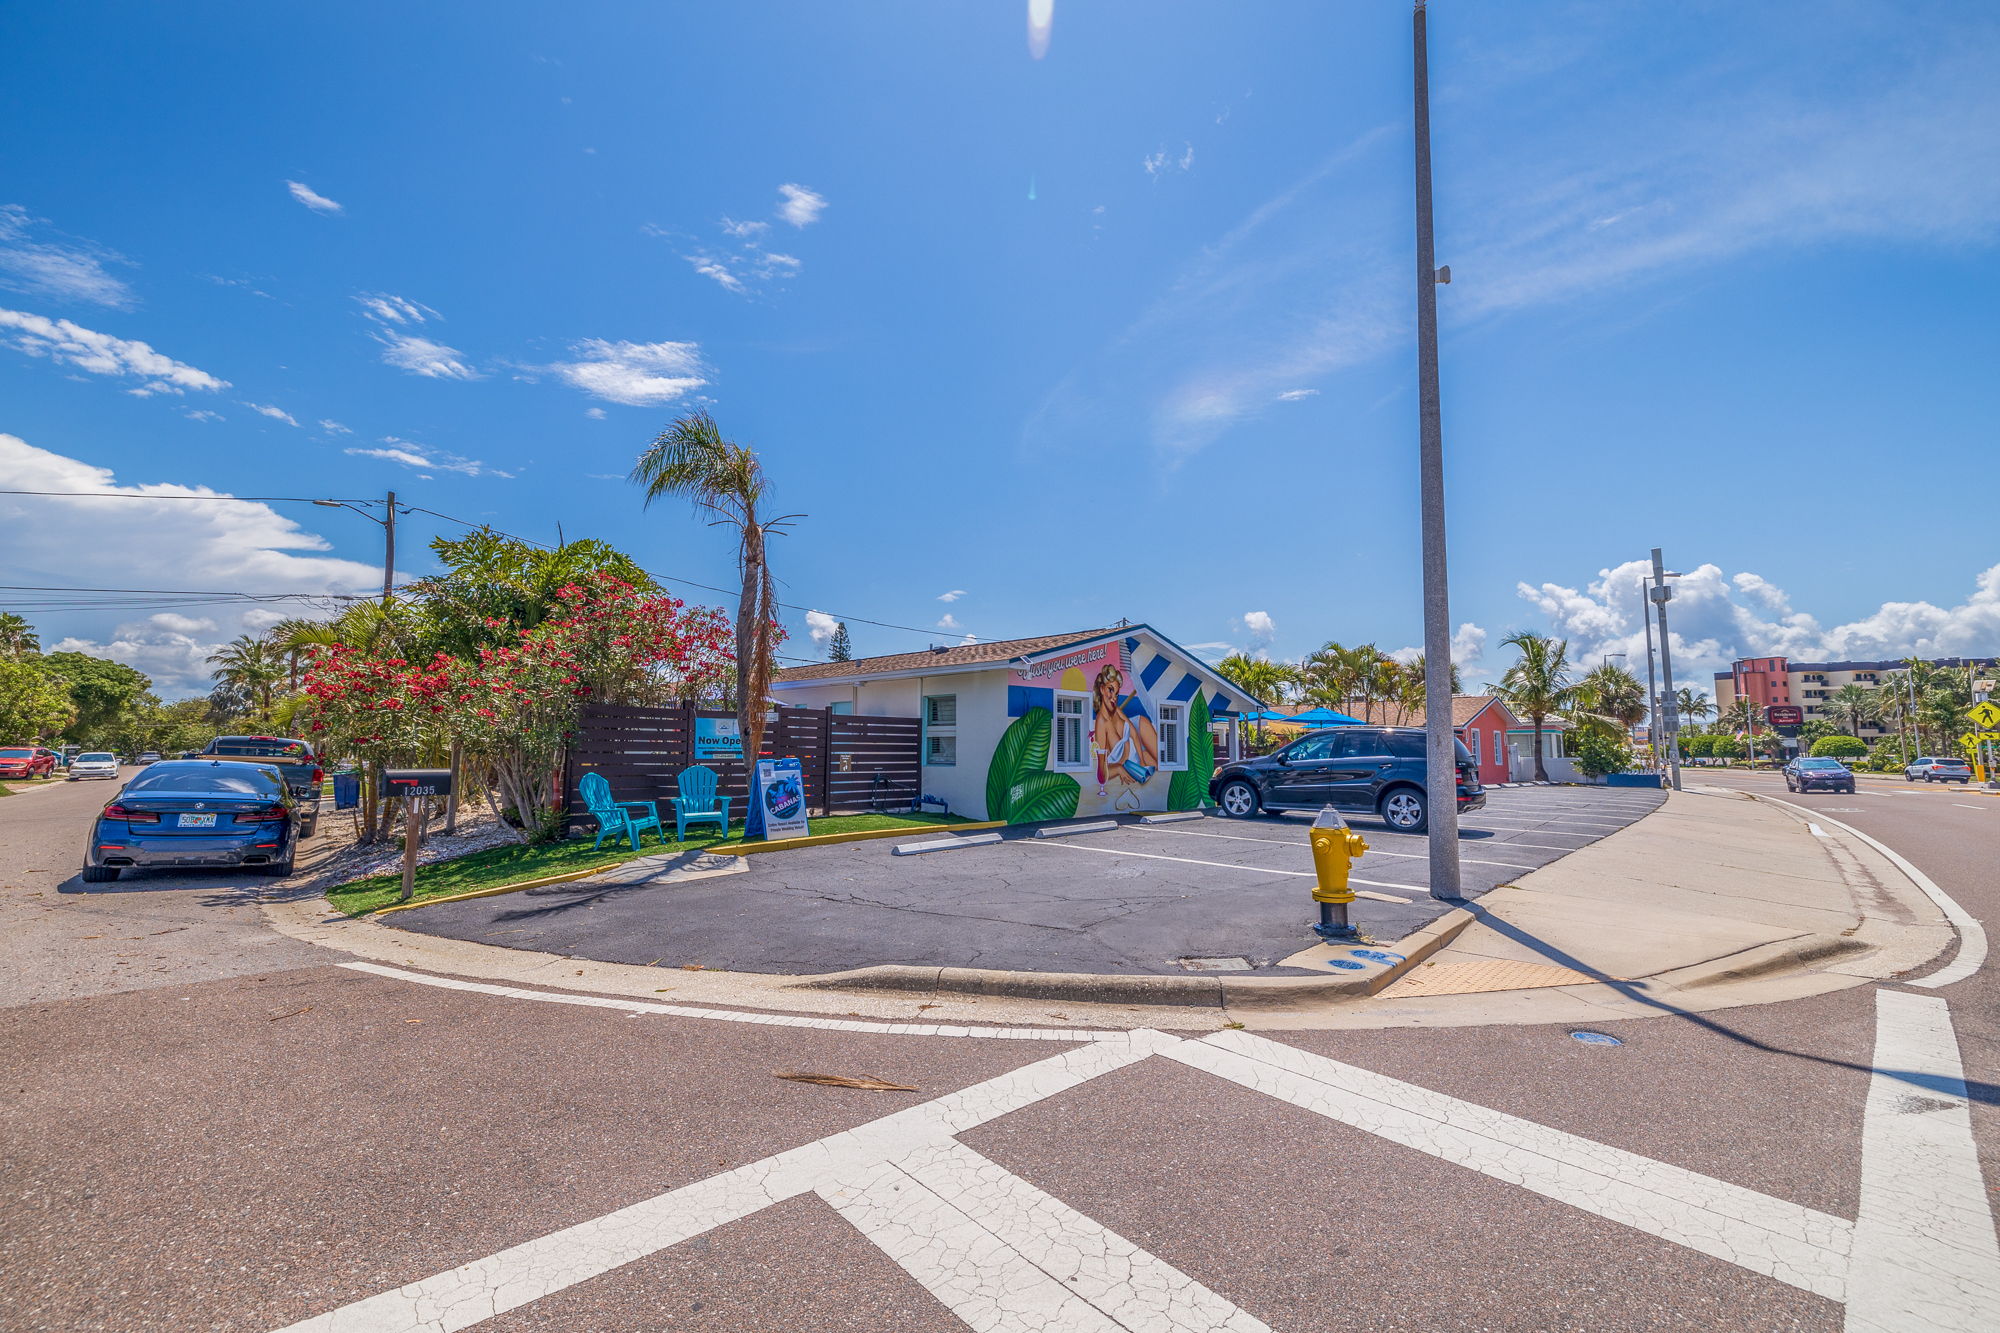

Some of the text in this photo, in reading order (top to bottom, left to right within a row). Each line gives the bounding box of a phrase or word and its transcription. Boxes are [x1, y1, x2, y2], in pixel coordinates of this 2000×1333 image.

[1046, 661, 1066, 679] you
[1065, 653, 1087, 669] were
[1087, 643, 1108, 661] here!
[698, 736, 741, 746] Now Ope
[404, 785, 436, 796] 12035
[770, 794, 801, 814] CABANAS
